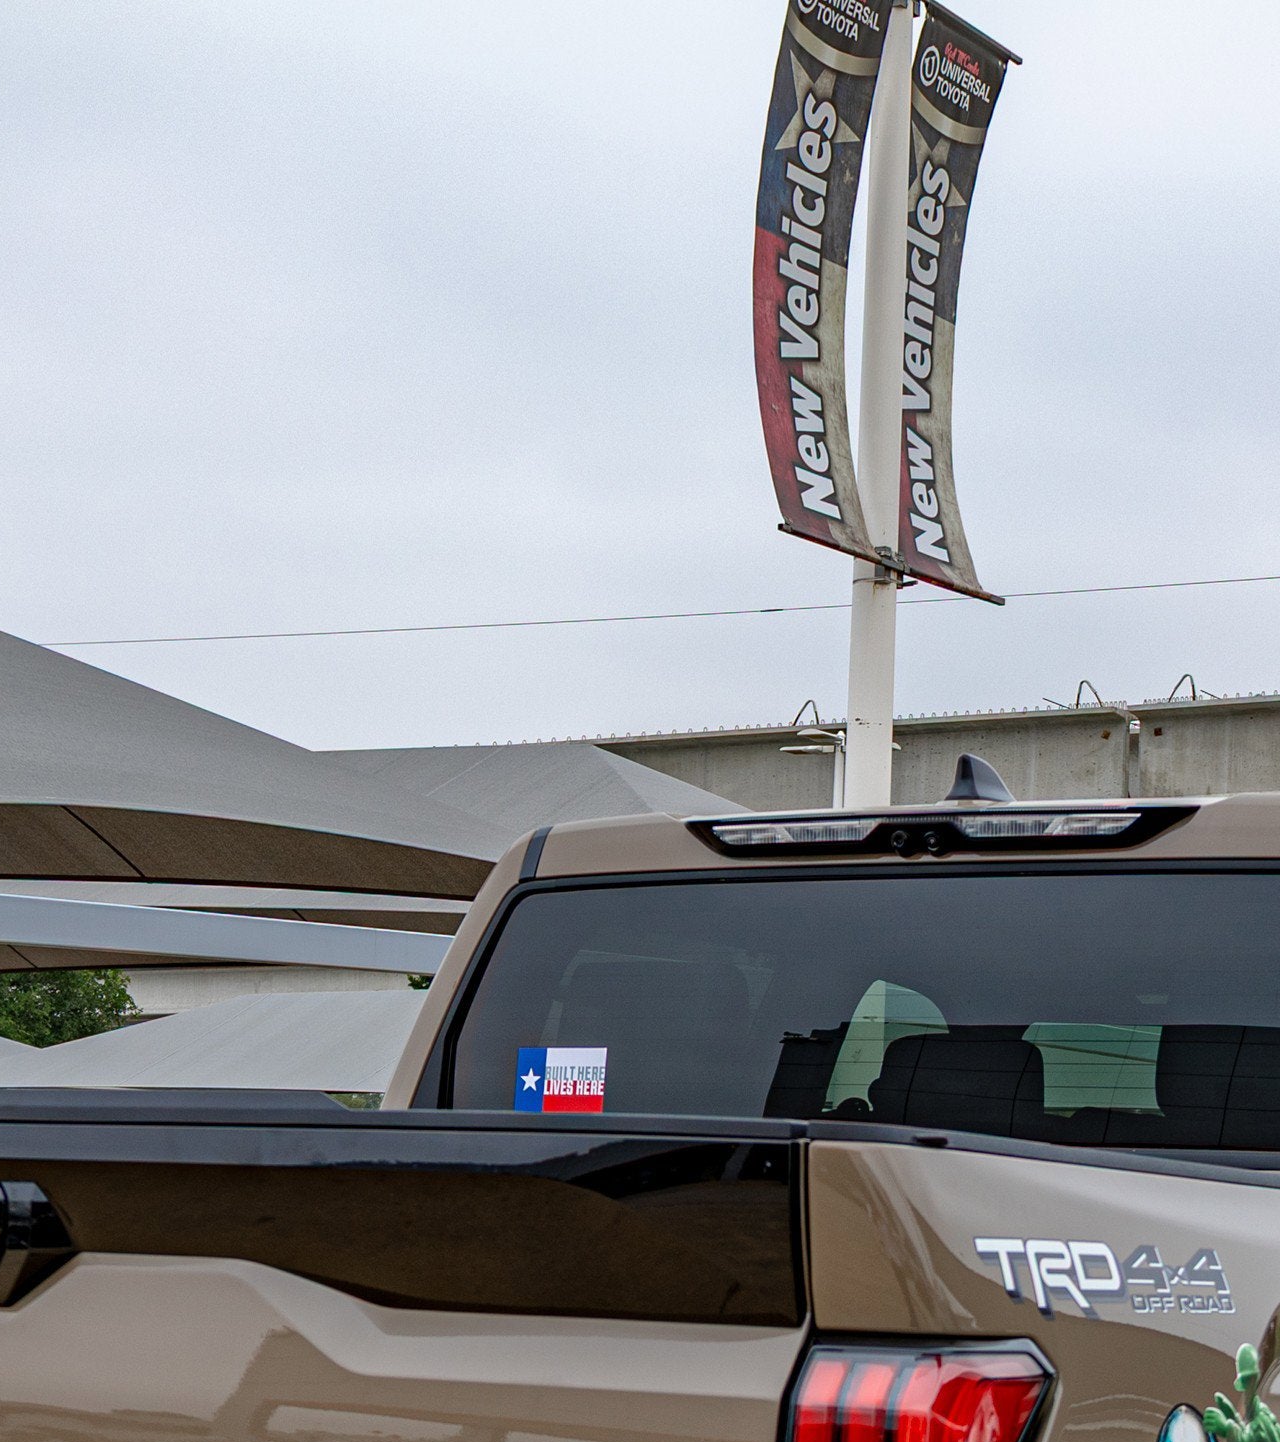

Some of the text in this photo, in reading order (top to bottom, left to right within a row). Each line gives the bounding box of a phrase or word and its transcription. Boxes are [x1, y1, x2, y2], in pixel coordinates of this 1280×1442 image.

[817, 3, 858, 42] TOYOTA
[936, 76, 970, 112] TOYOTA
[940, 57, 991, 104] UNIVERSAL
[778, 93, 843, 520] New Vehicles
[901, 160, 951, 563] New Vehicles
[544, 1080, 605, 1095] LIVES HERE
[545, 1066, 606, 1080] BUILT HERE
[975, 1237, 1124, 1314] TRD
[1132, 1294, 1236, 1314] OFF ROAD
